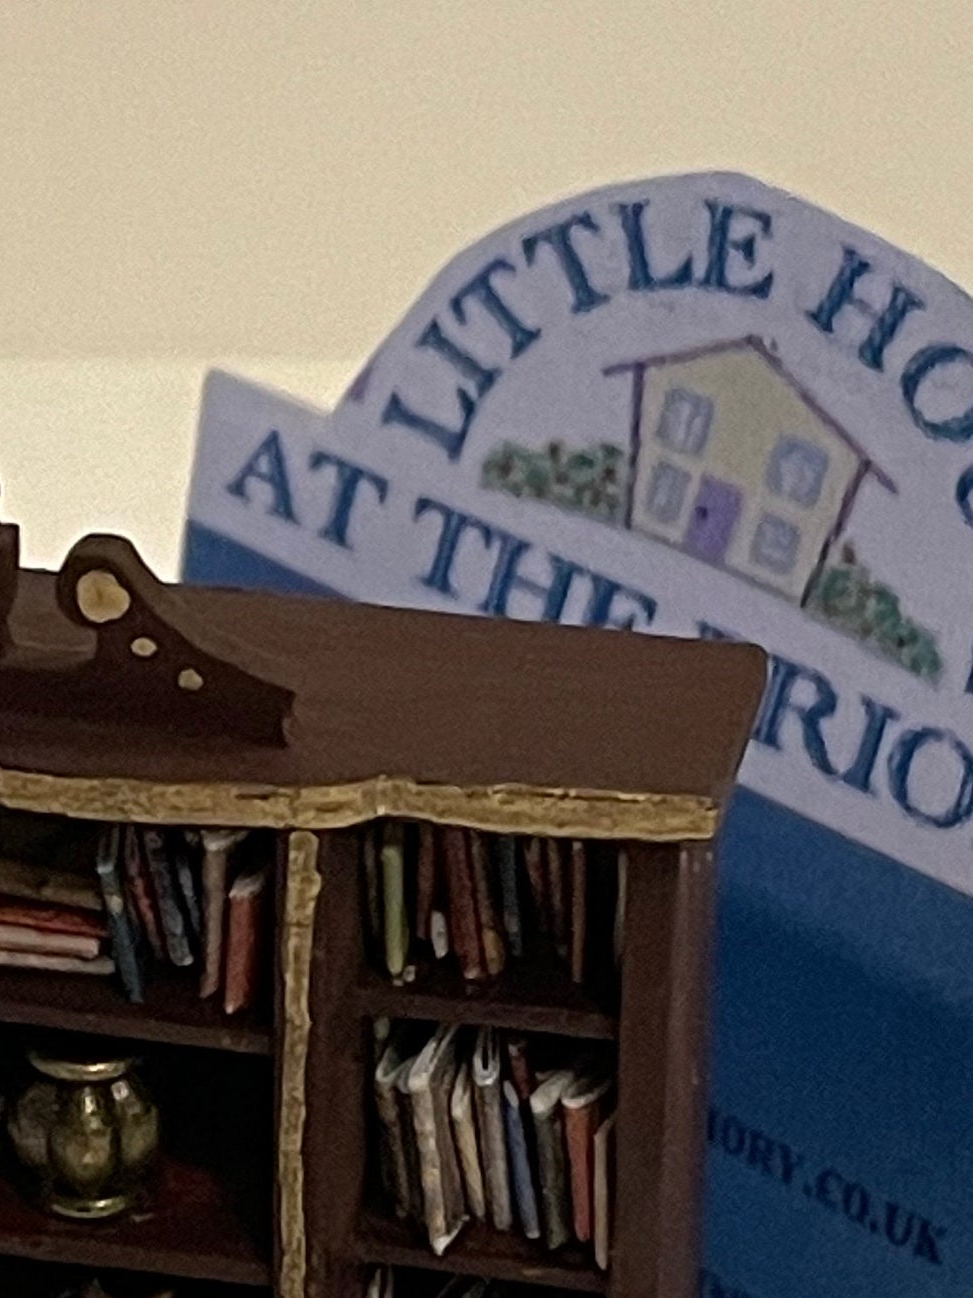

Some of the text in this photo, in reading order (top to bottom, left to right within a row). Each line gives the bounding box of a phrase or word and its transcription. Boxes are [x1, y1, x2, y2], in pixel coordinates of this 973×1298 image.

[382, 197, 973, 528] LITTLE HO
[227, 429, 389, 550] AT
[698, 620, 973, 829] RIO
